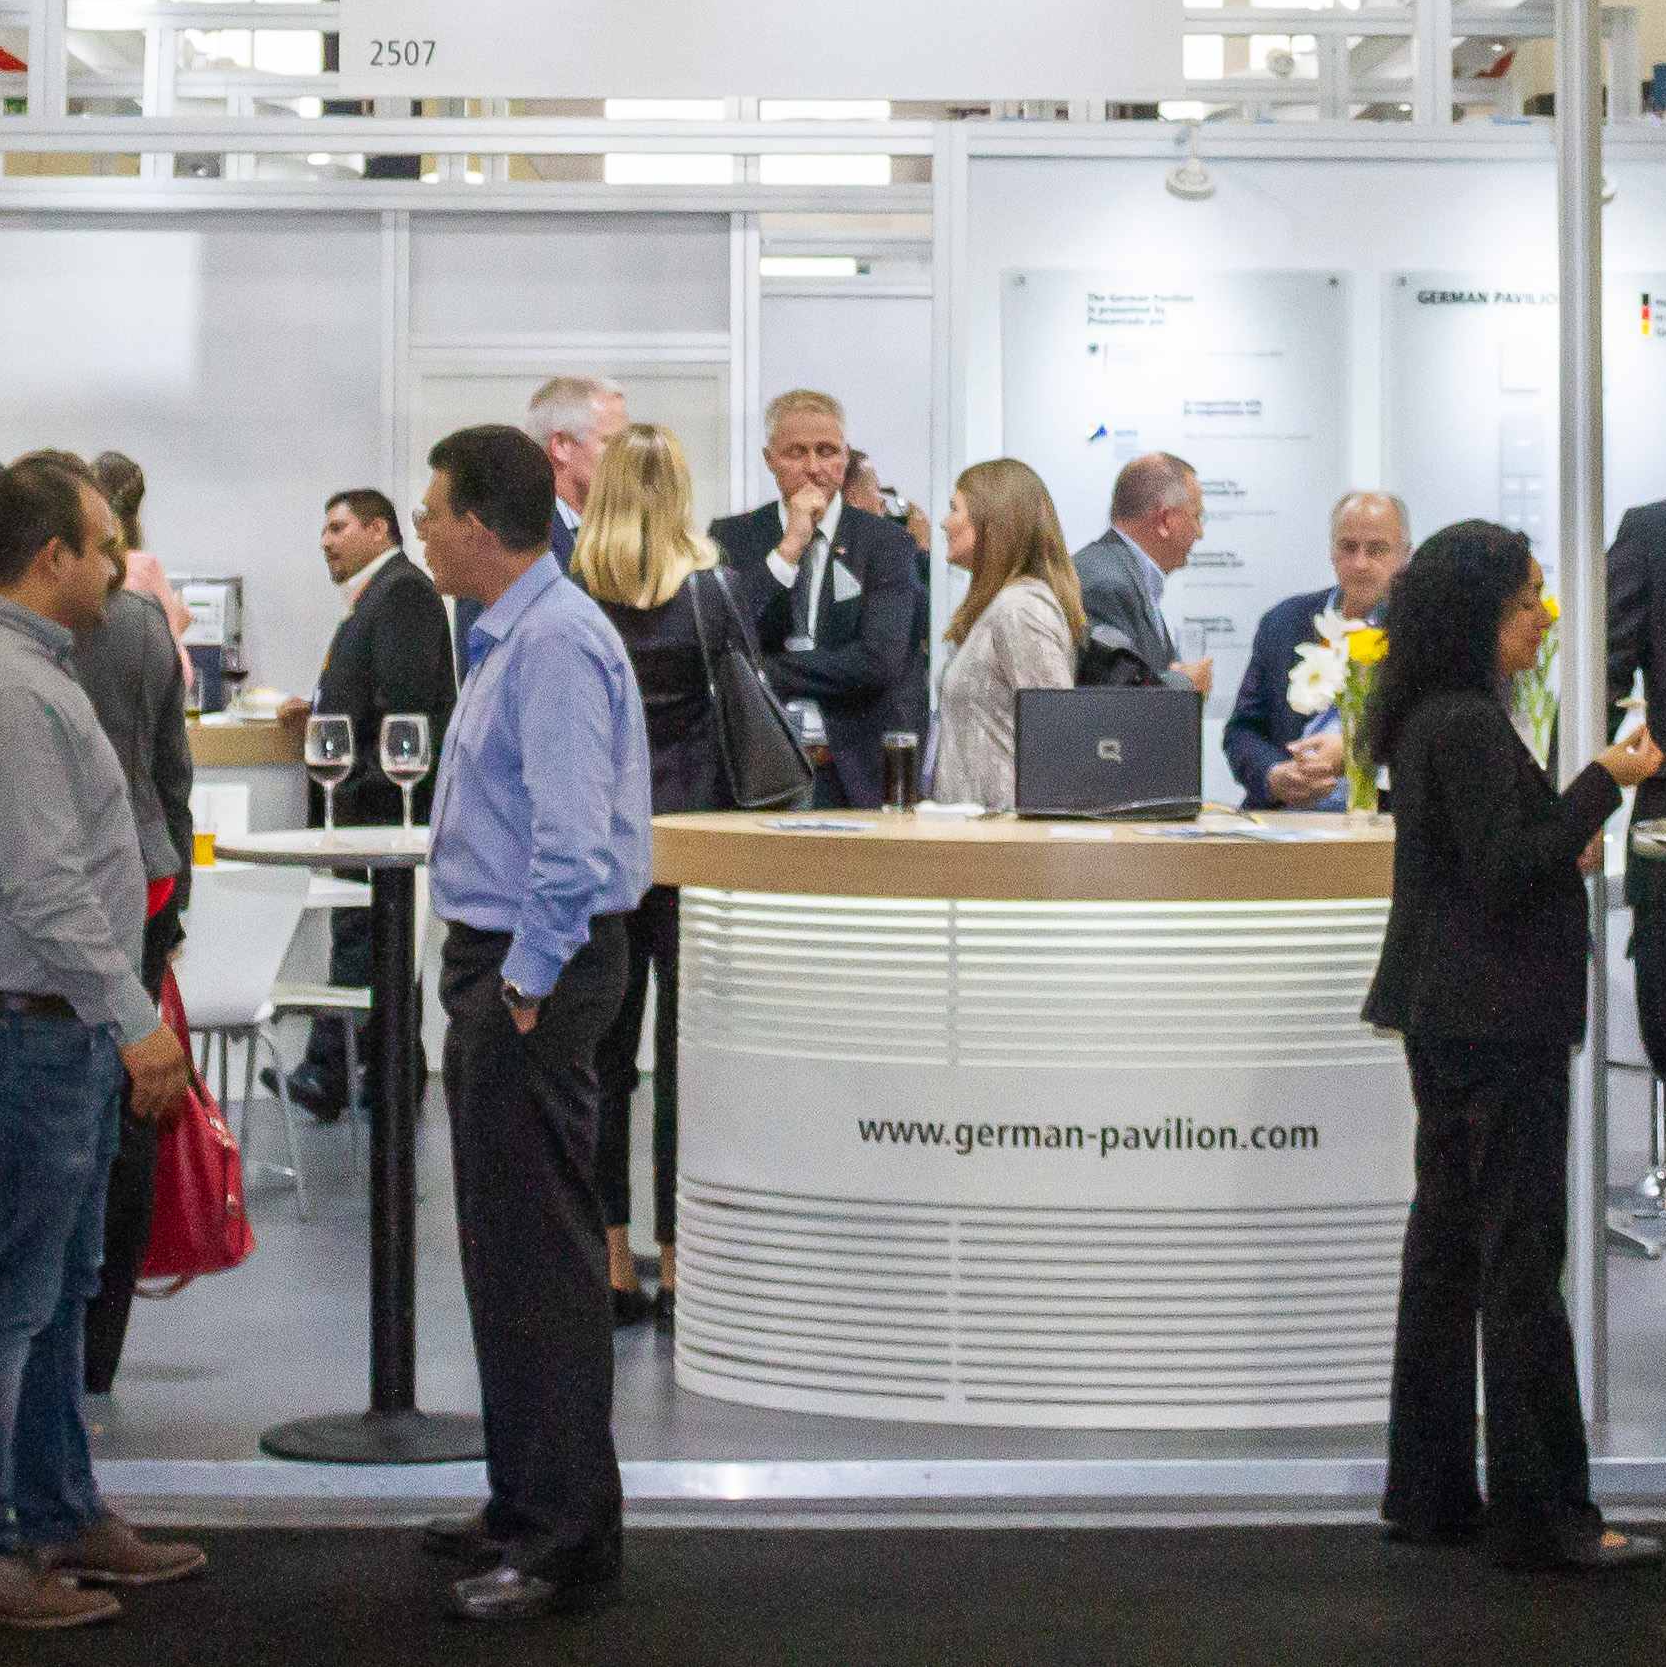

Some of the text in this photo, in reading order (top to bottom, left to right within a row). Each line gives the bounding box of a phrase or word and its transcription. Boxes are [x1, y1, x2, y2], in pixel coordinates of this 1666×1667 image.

[370, 39, 436, 67] 2507
[1416, 289, 1560, 305] GERMAN PAVILIO
